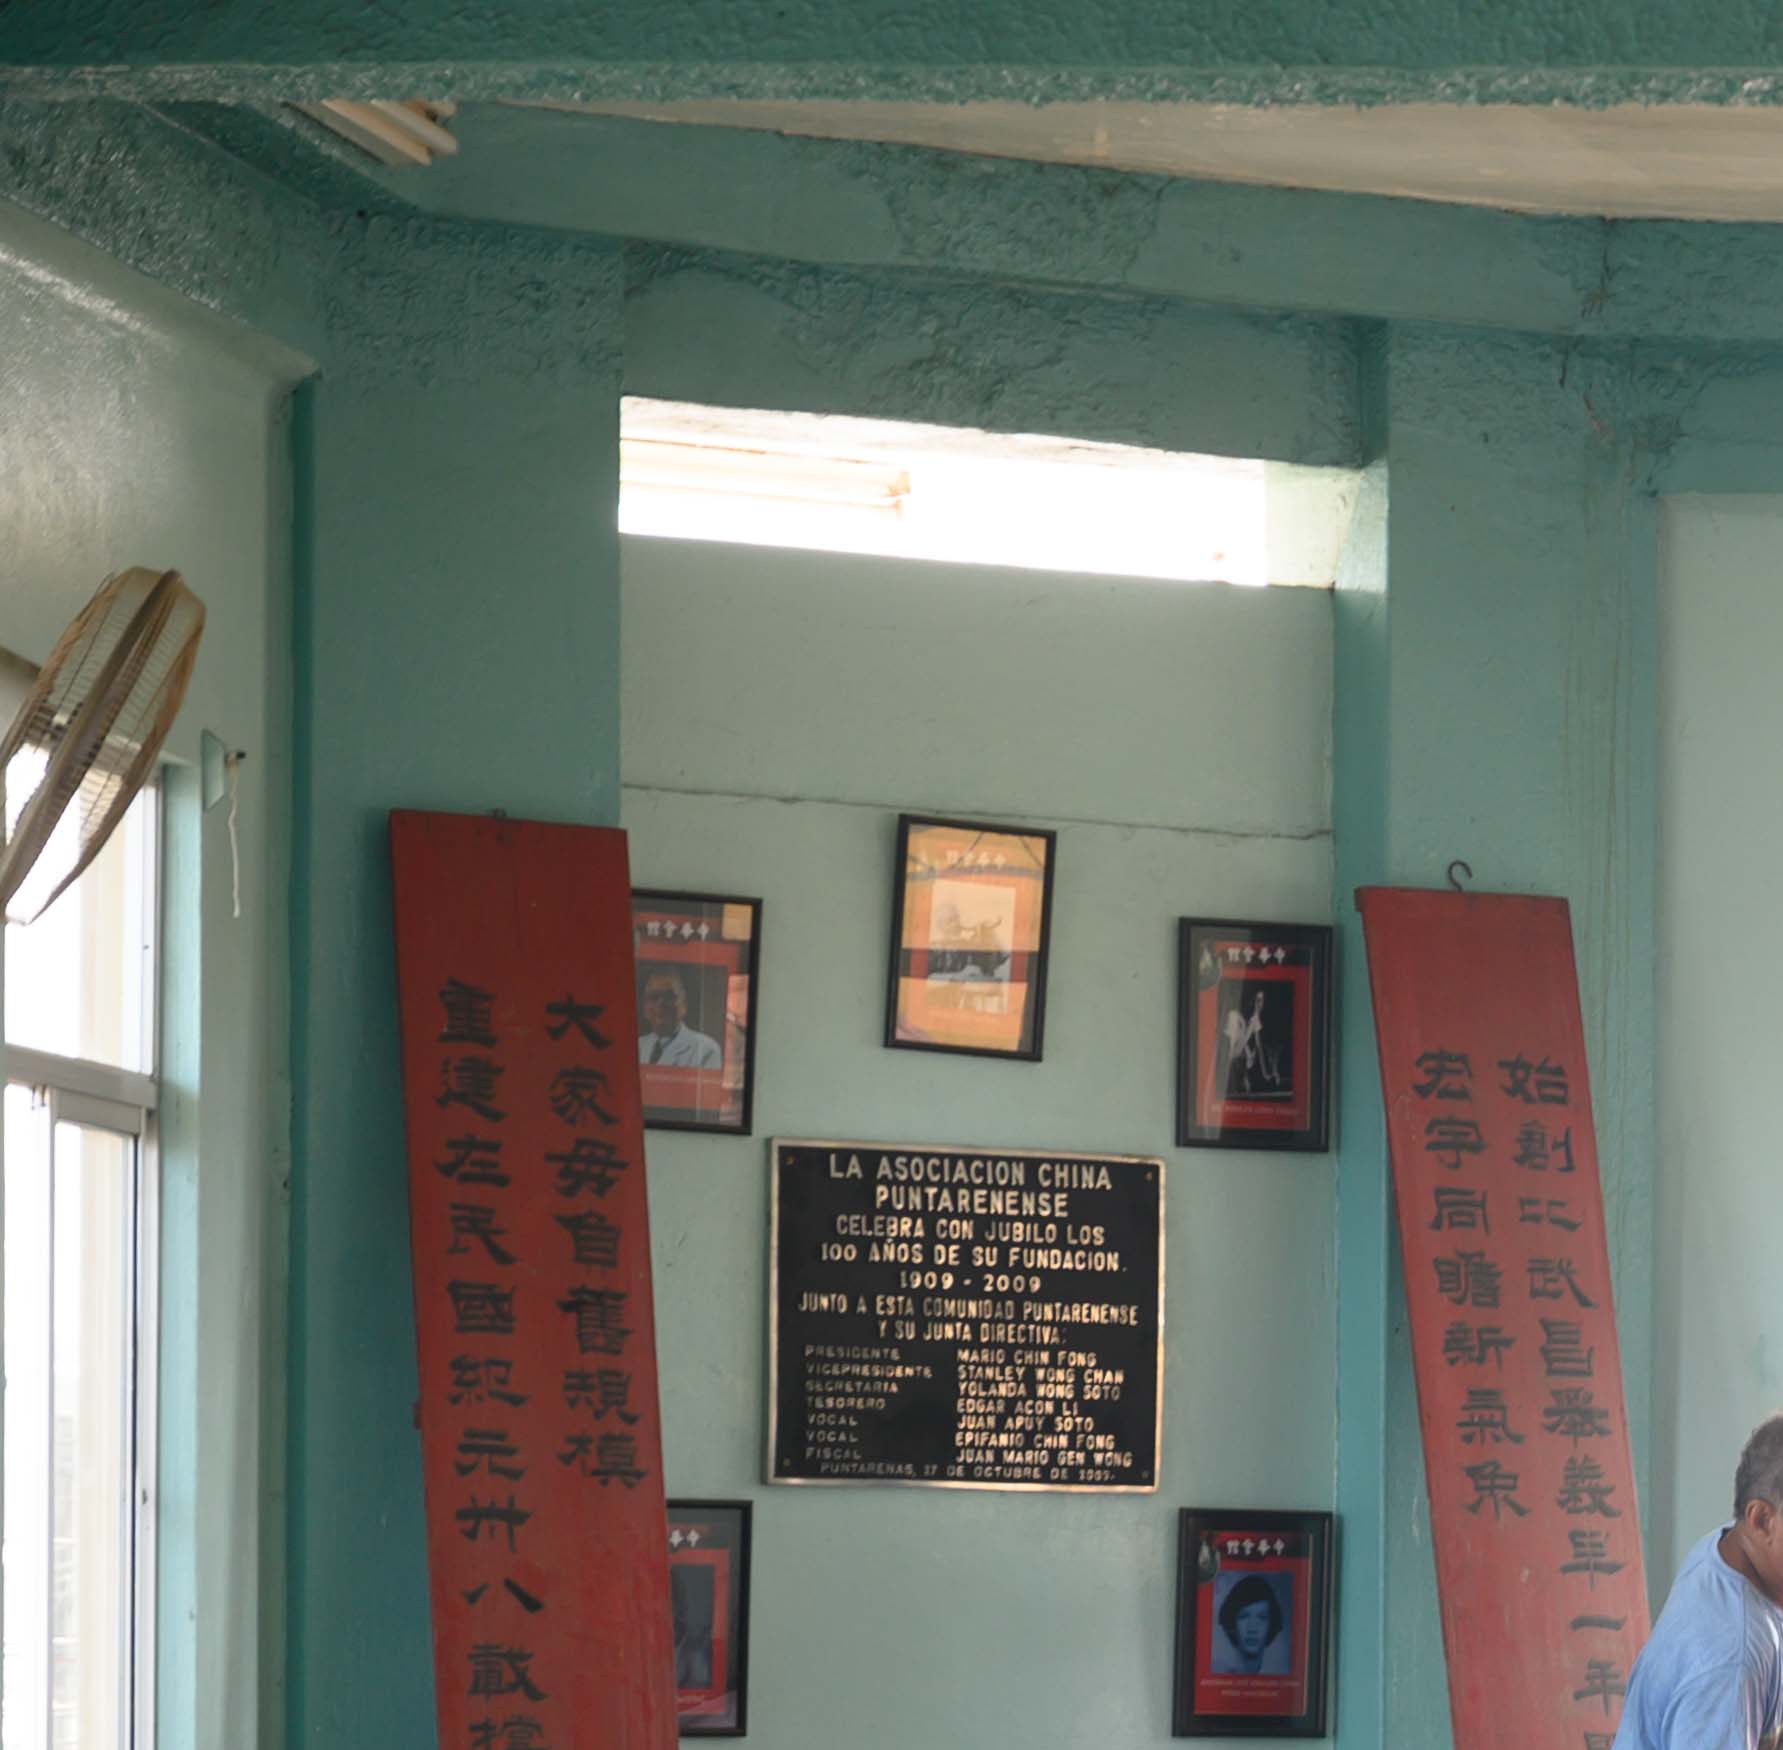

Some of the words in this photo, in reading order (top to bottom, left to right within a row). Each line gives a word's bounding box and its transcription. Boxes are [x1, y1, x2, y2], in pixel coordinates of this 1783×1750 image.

[829, 1153, 863, 1179] LA
[876, 1156, 1025, 1186] ASOCIACION
[1038, 1163, 1112, 1190] CHINA
[875, 1186, 1068, 1217] PUNTARENENSE
[836, 1214, 925, 1239] CELEBRA
[936, 1219, 974, 1240] CON
[985, 1221, 1057, 1244] JUBILO
[1067, 1225, 1104, 1246] LOS
[821, 1243, 857, 1262] 100
[868, 1237, 924, 1264] AÑOS
[934, 1245, 960, 1266] DE
[972, 1246, 998, 1267] SU
[1009, 1247, 1127, 1272] FUNDACION.
[900, 1271, 954, 1290] 1909
[983, 1274, 1041, 1293] 2009
[798, 1292, 848, 1313] JUNTO
[856, 1295, 867, 1314] A
[876, 1295, 914, 1317] ESTA
[923, 1297, 1015, 1321] COMUNIDAD
[1023, 1300, 1139, 1326] PUNTARENENSE
[878, 1320, 888, 1338] Y
[895, 1321, 915, 1340] SU
[923, 1322, 972, 1342] JUNTA
[805, 1345, 901, 1361] PRESIDENTE
[956, 1348, 1006, 1363] MARIO
[1014, 1349, 1050, 1366] CHIN
[1057, 1351, 1097, 1367] FONG
[806, 1363, 933, 1378] VICEPRESIDENTE
[957, 1366, 1027, 1381] STANLEY
[1035, 1367, 1076, 1382] WONG
[1083, 1369, 1125, 1384] CHAN
[805, 1380, 899, 1394] SECRETARIA
[957, 1381, 1027, 1397] YOLANDA
[1036, 1384, 1075, 1399] WONG
[1083, 1385, 1121, 1401] SOTO
[806, 1396, 887, 1410] TESORERO
[957, 1399, 1005, 1414] EDGAR
[807, 1413, 859, 1426] VOCAL
[957, 1415, 996, 1430] JUAN
[1054, 1417, 1095, 1432] SOTO
[806, 1430, 859, 1443] VOCAL
[955, 1432, 1025, 1447] EPIFANIO
[1033, 1434, 1069, 1449] CHIN
[1076, 1434, 1116, 1450] FONG
[805, 1447, 862, 1460] FISCAL
[955, 1449, 995, 1464] JUAN
[1002, 1450, 1049, 1465] MARIO
[1093, 1452, 1133, 1468] WONG
[946, 1466, 965, 1477] DE
[973, 1467, 1042, 1479] OCTUBRE
[1050, 1468, 1069, 1480] DE
